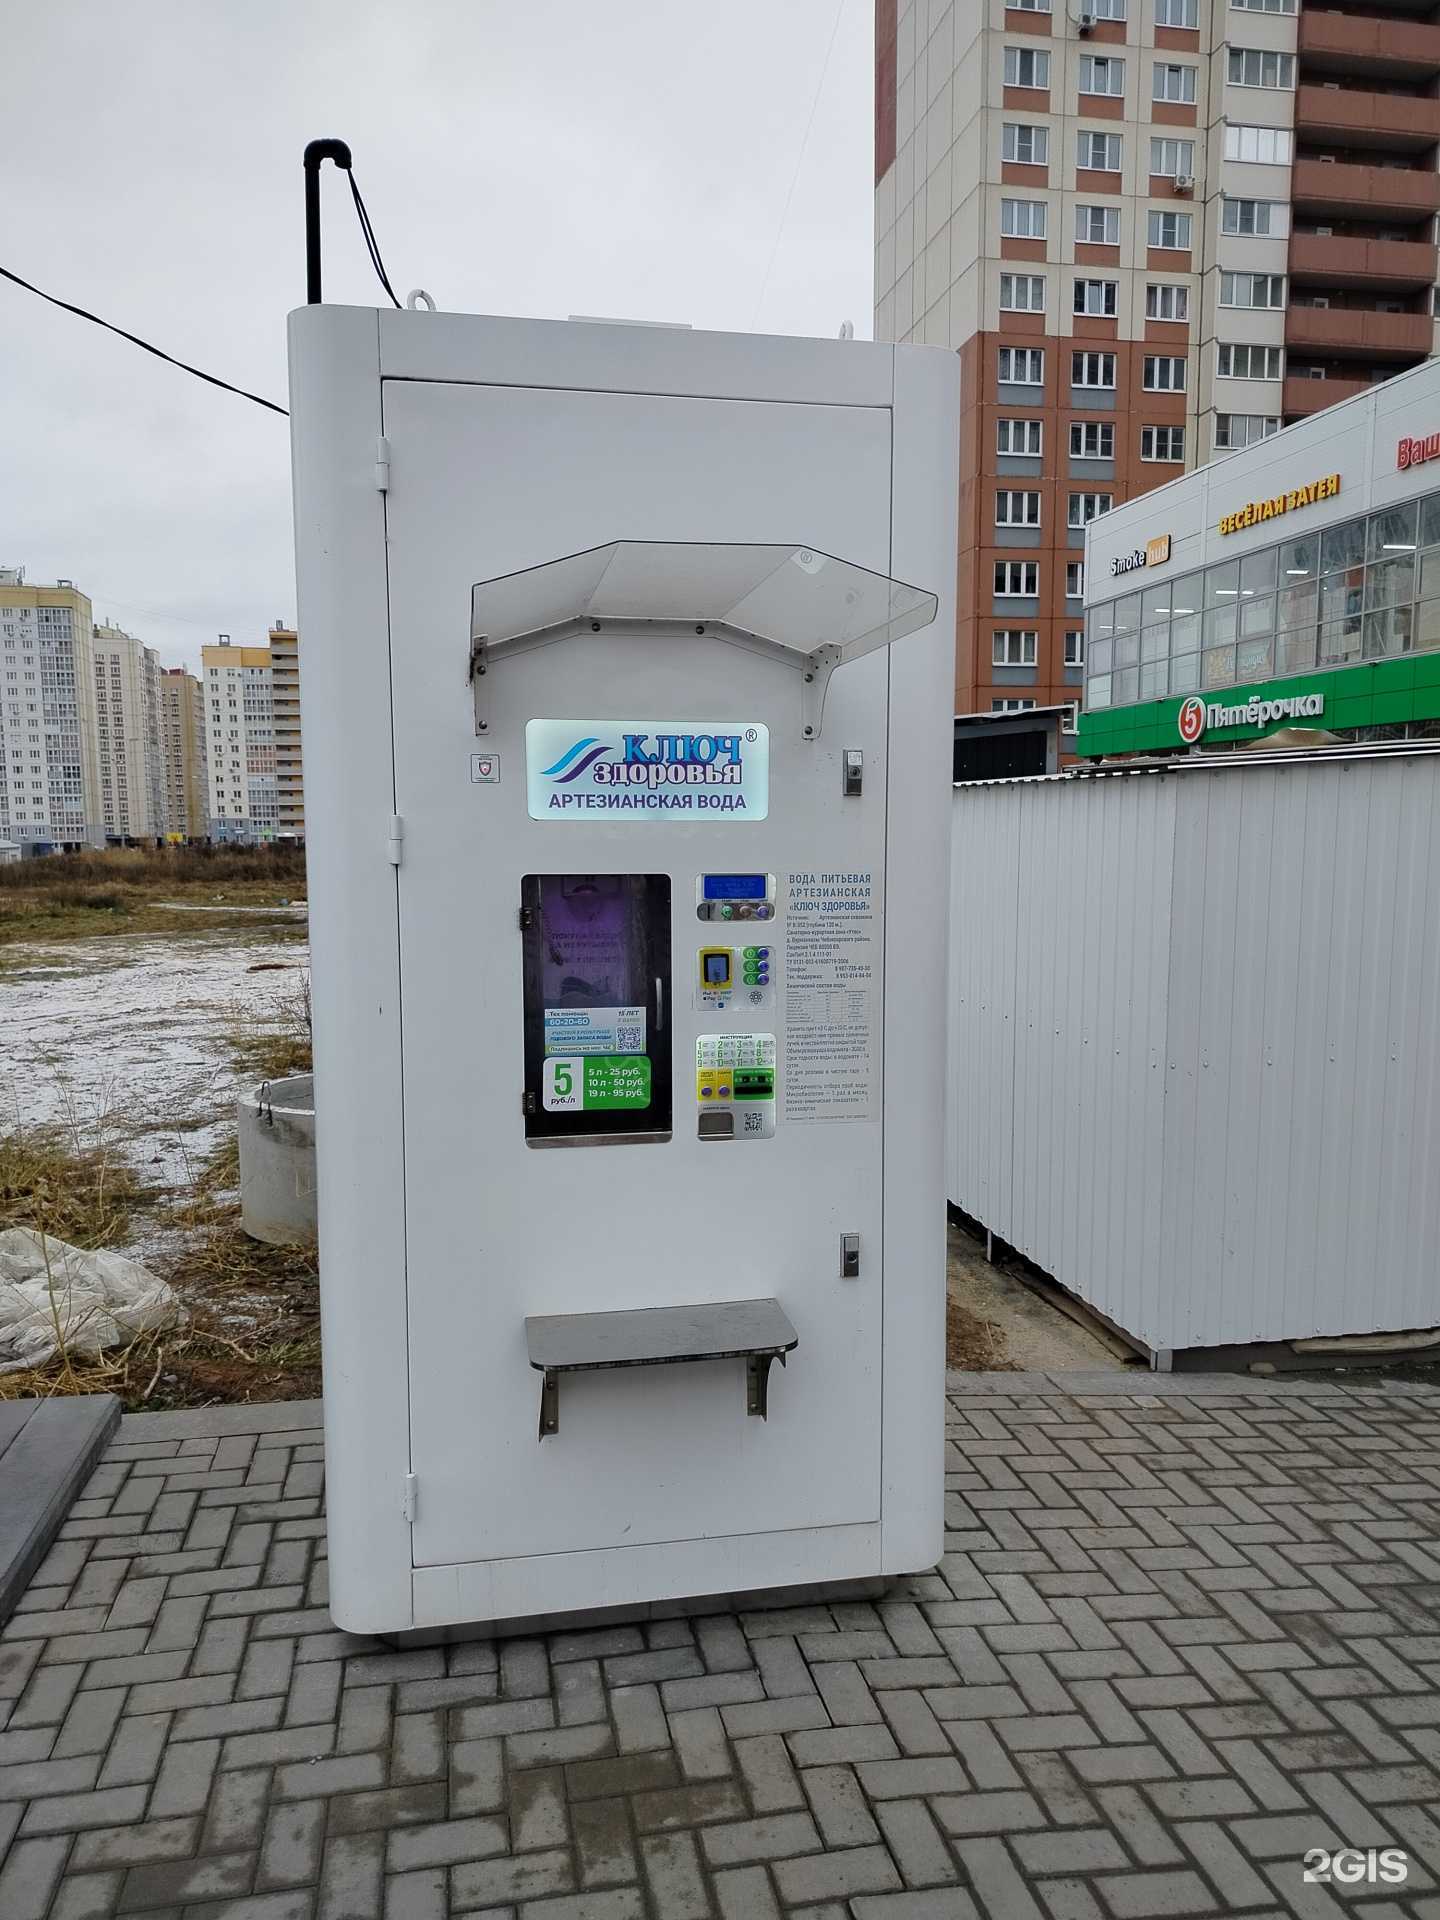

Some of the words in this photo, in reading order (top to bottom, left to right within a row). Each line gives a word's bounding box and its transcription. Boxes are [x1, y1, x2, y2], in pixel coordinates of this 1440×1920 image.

[1219, 495, 1287, 535] ВЕСЁЛАЯ
[1110, 550, 1146, 577] Smoke
[1207, 693, 1324, 729] Пятёрочка
[622, 734, 743, 764] КЛЮЧ
[548, 793, 693, 809] АРТЕЗИАНСКАЯ
[699, 794, 747, 812] ВОДА
[789, 874, 816, 886] ВОДА
[821, 873, 871, 884] ПИТЬЕВАЯ
[789, 887, 871, 898] АРТЕЗИАНСКАЯ
[554, 1063, 573, 1096] 5
[588, 1068, 595, 1076] 5
[609, 1068, 620, 1076] 25
[622, 1067, 641, 1077] руб.
[588, 1079, 598, 1087] 10
[613, 1078, 625, 1086] 50
[626, 1078, 645, 1087] руб.
[551, 1096, 576, 1105] руб./л
[588, 1089, 598, 1097] 19
[613, 1089, 624, 1097] 95
[625, 1088, 644, 1098] руб.
